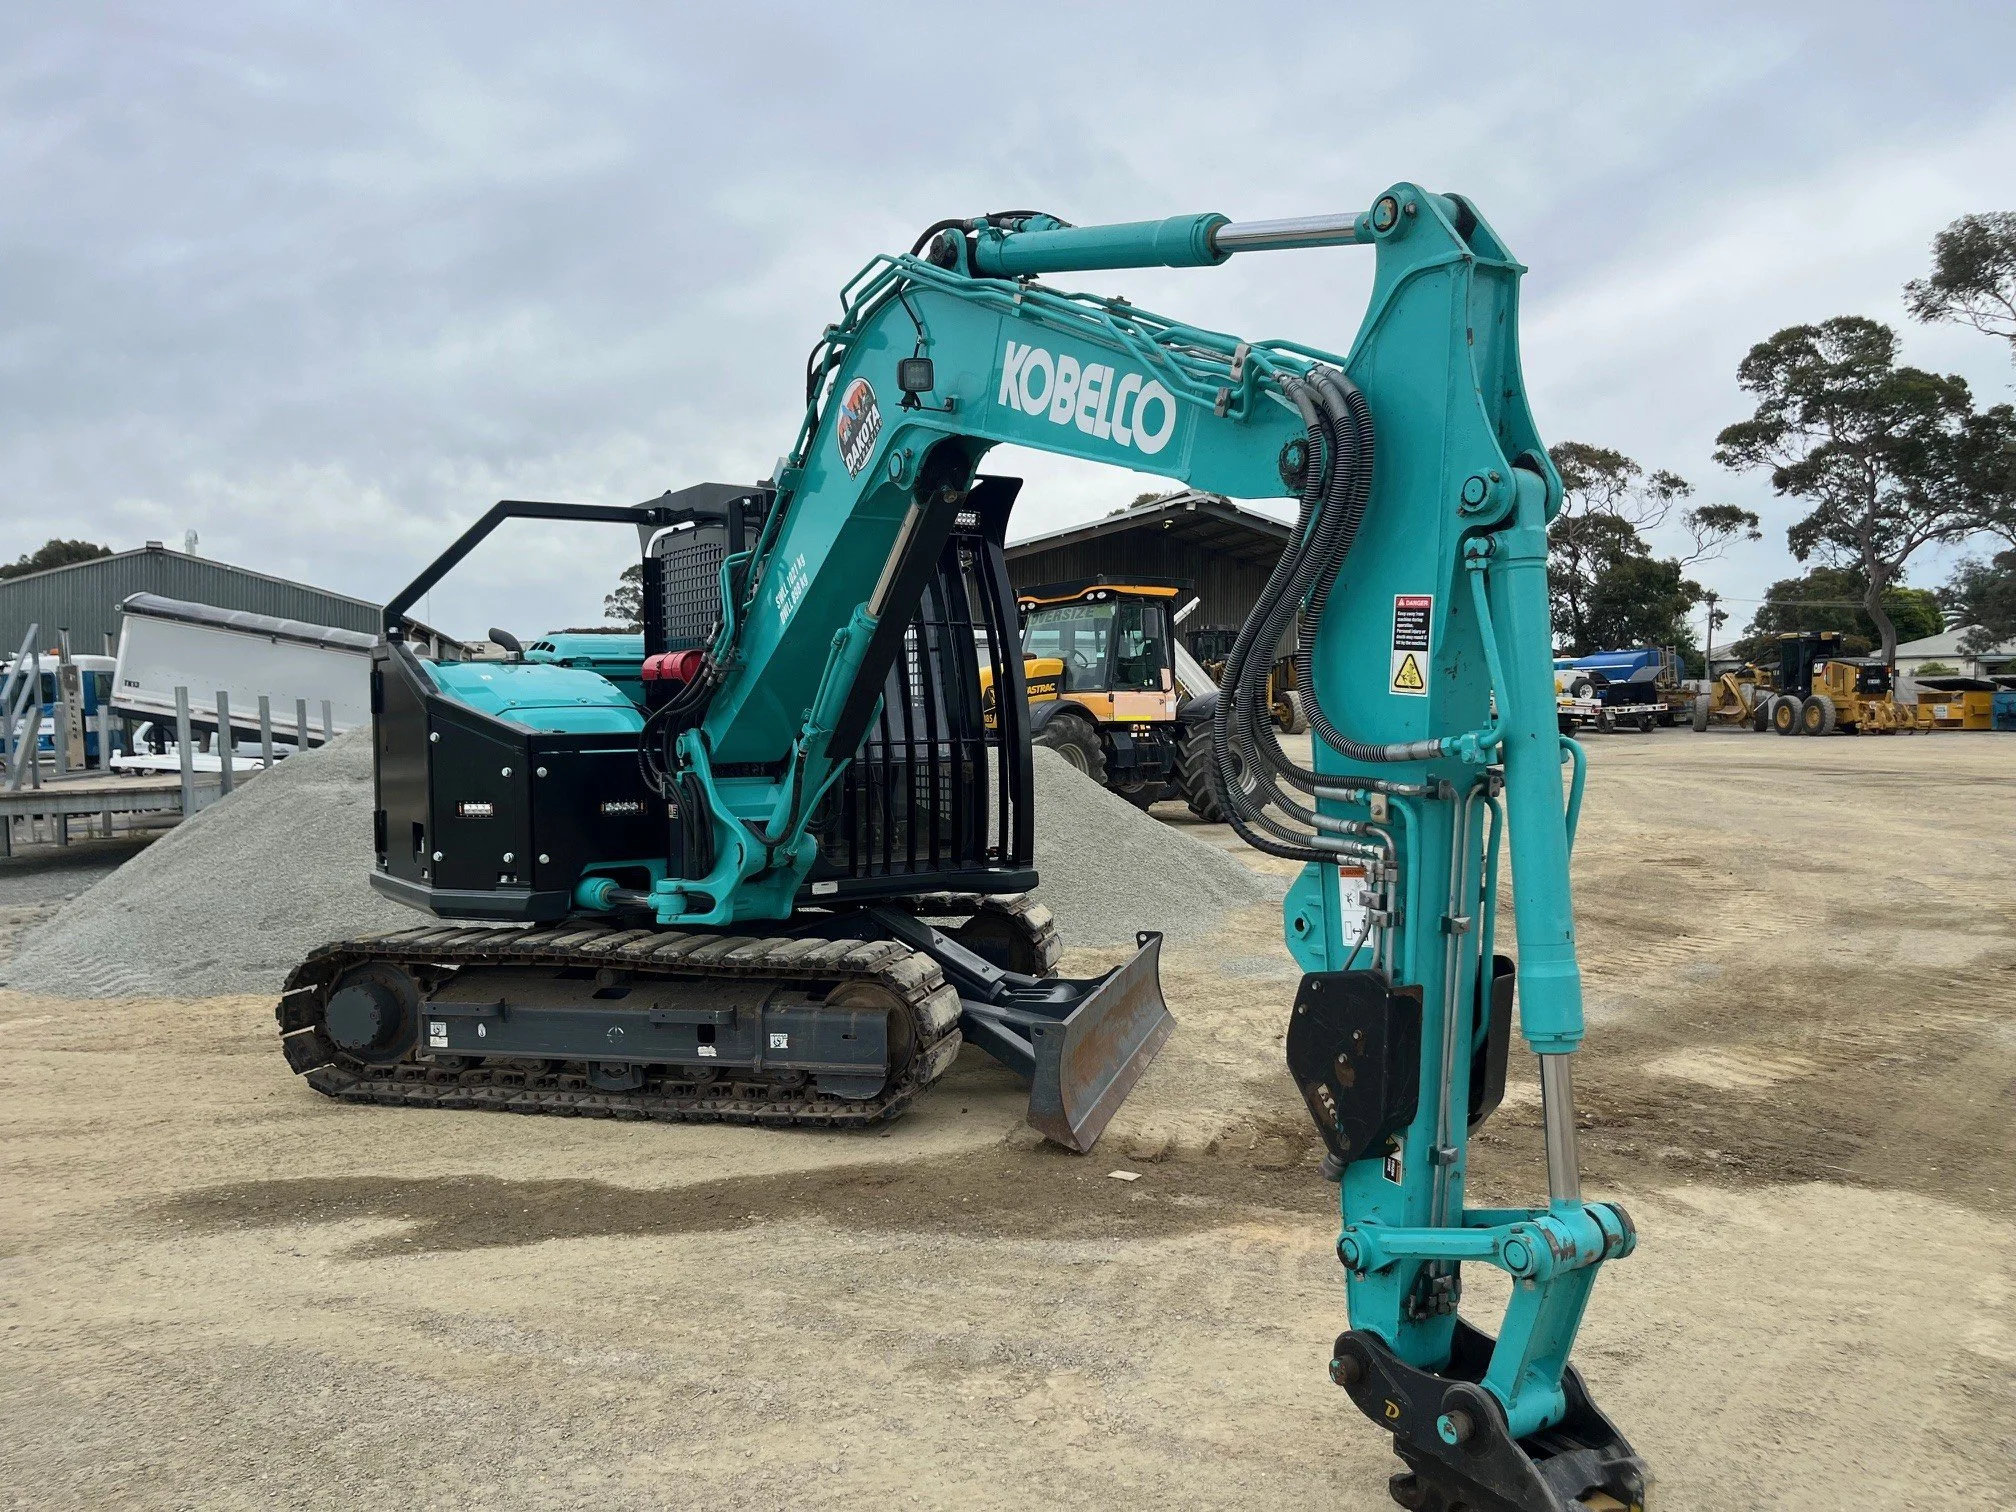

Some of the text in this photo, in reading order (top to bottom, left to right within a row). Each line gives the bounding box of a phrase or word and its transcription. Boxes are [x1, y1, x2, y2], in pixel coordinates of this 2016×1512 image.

[998, 341, 1177, 455] KOBELCO
[846, 404, 880, 474] DAKOTA
[1031, 606, 1094, 625] OVERSIZE
[1027, 682, 1056, 695] ASTRAC
